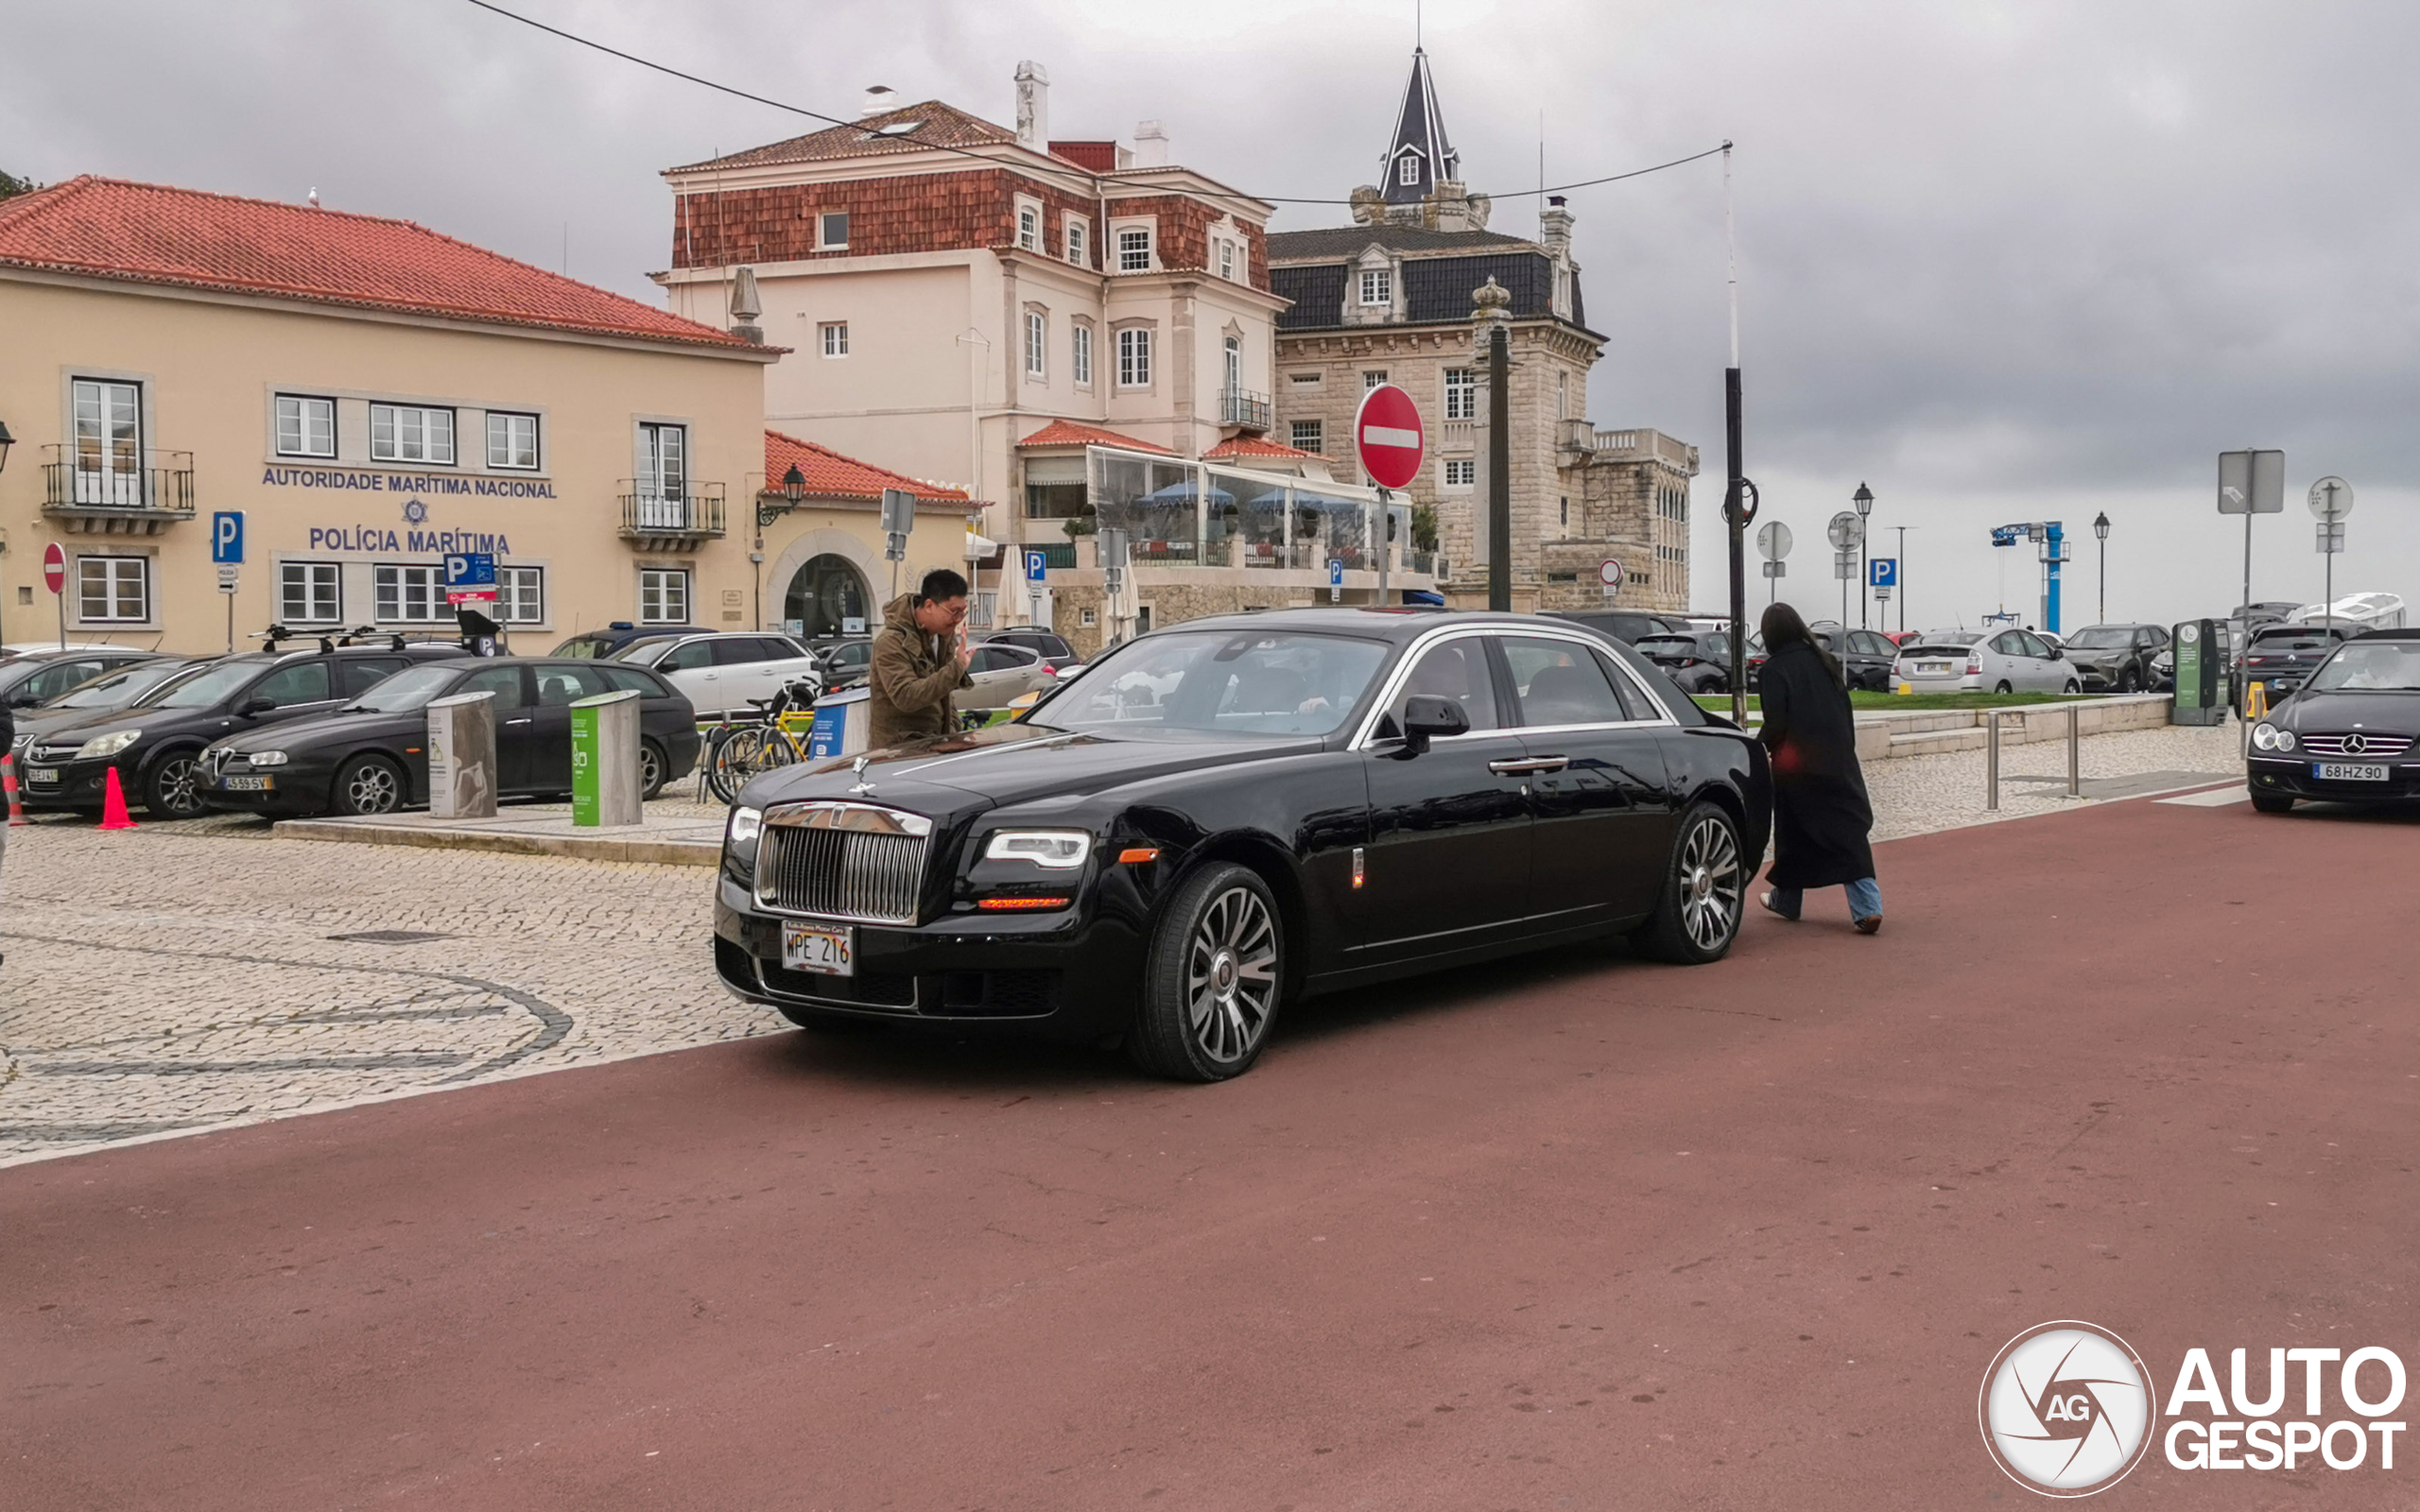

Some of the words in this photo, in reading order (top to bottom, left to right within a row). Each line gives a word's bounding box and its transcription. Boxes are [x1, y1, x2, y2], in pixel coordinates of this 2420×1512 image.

[262, 468, 384, 491] AUTORIDADE
[388, 473, 473, 495] MARÍTIMA
[475, 479, 558, 499] NACIONAL
[218, 516, 237, 558] P
[309, 524, 401, 552] POLÍCIA
[407, 526, 510, 556] MARÍTIMA
[447, 557, 469, 583] P
[1030, 554, 1042, 578] P
[1332, 561, 1340, 583] P
[1875, 560, 1891, 584] P
[786, 932, 813, 960] WPE
[821, 936, 849, 964] 216
